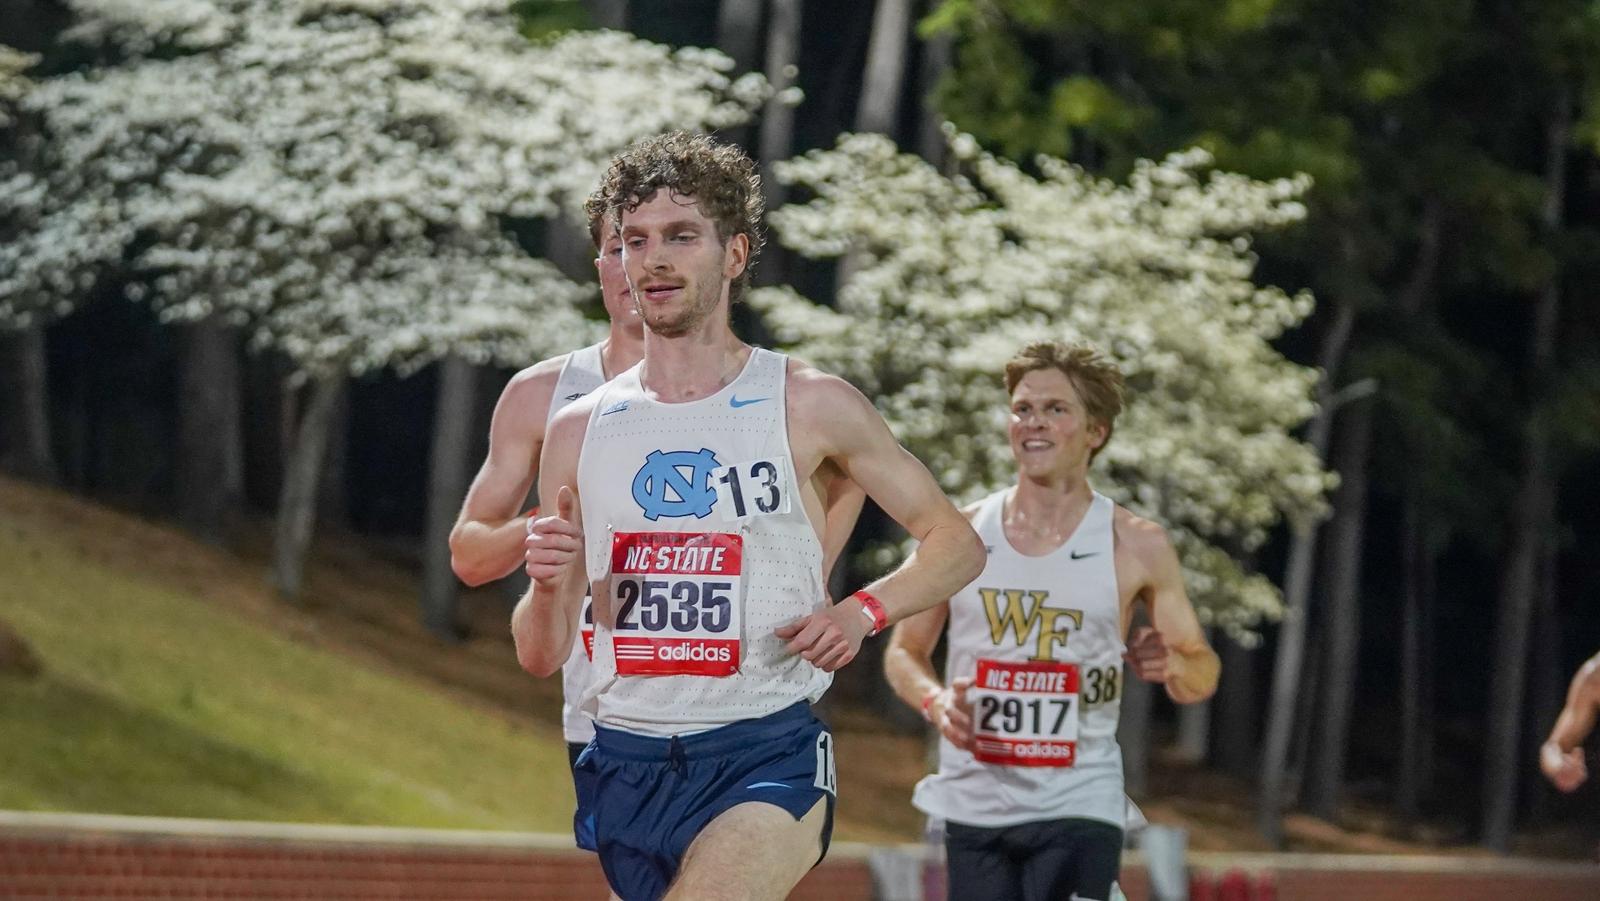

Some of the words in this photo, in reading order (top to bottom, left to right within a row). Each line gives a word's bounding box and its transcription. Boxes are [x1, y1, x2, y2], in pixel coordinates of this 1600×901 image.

[719, 461, 781, 517] 13
[624, 546, 652, 570] NC
[656, 546, 727, 572] STATE
[615, 579, 732, 633] 2535
[658, 642, 731, 662] adidas
[985, 669, 1011, 690] NC
[1013, 671, 1068, 692] STATE
[1082, 665, 1118, 704] 38
[979, 695, 1071, 735] 2917
[1014, 742, 1072, 758] adidas
